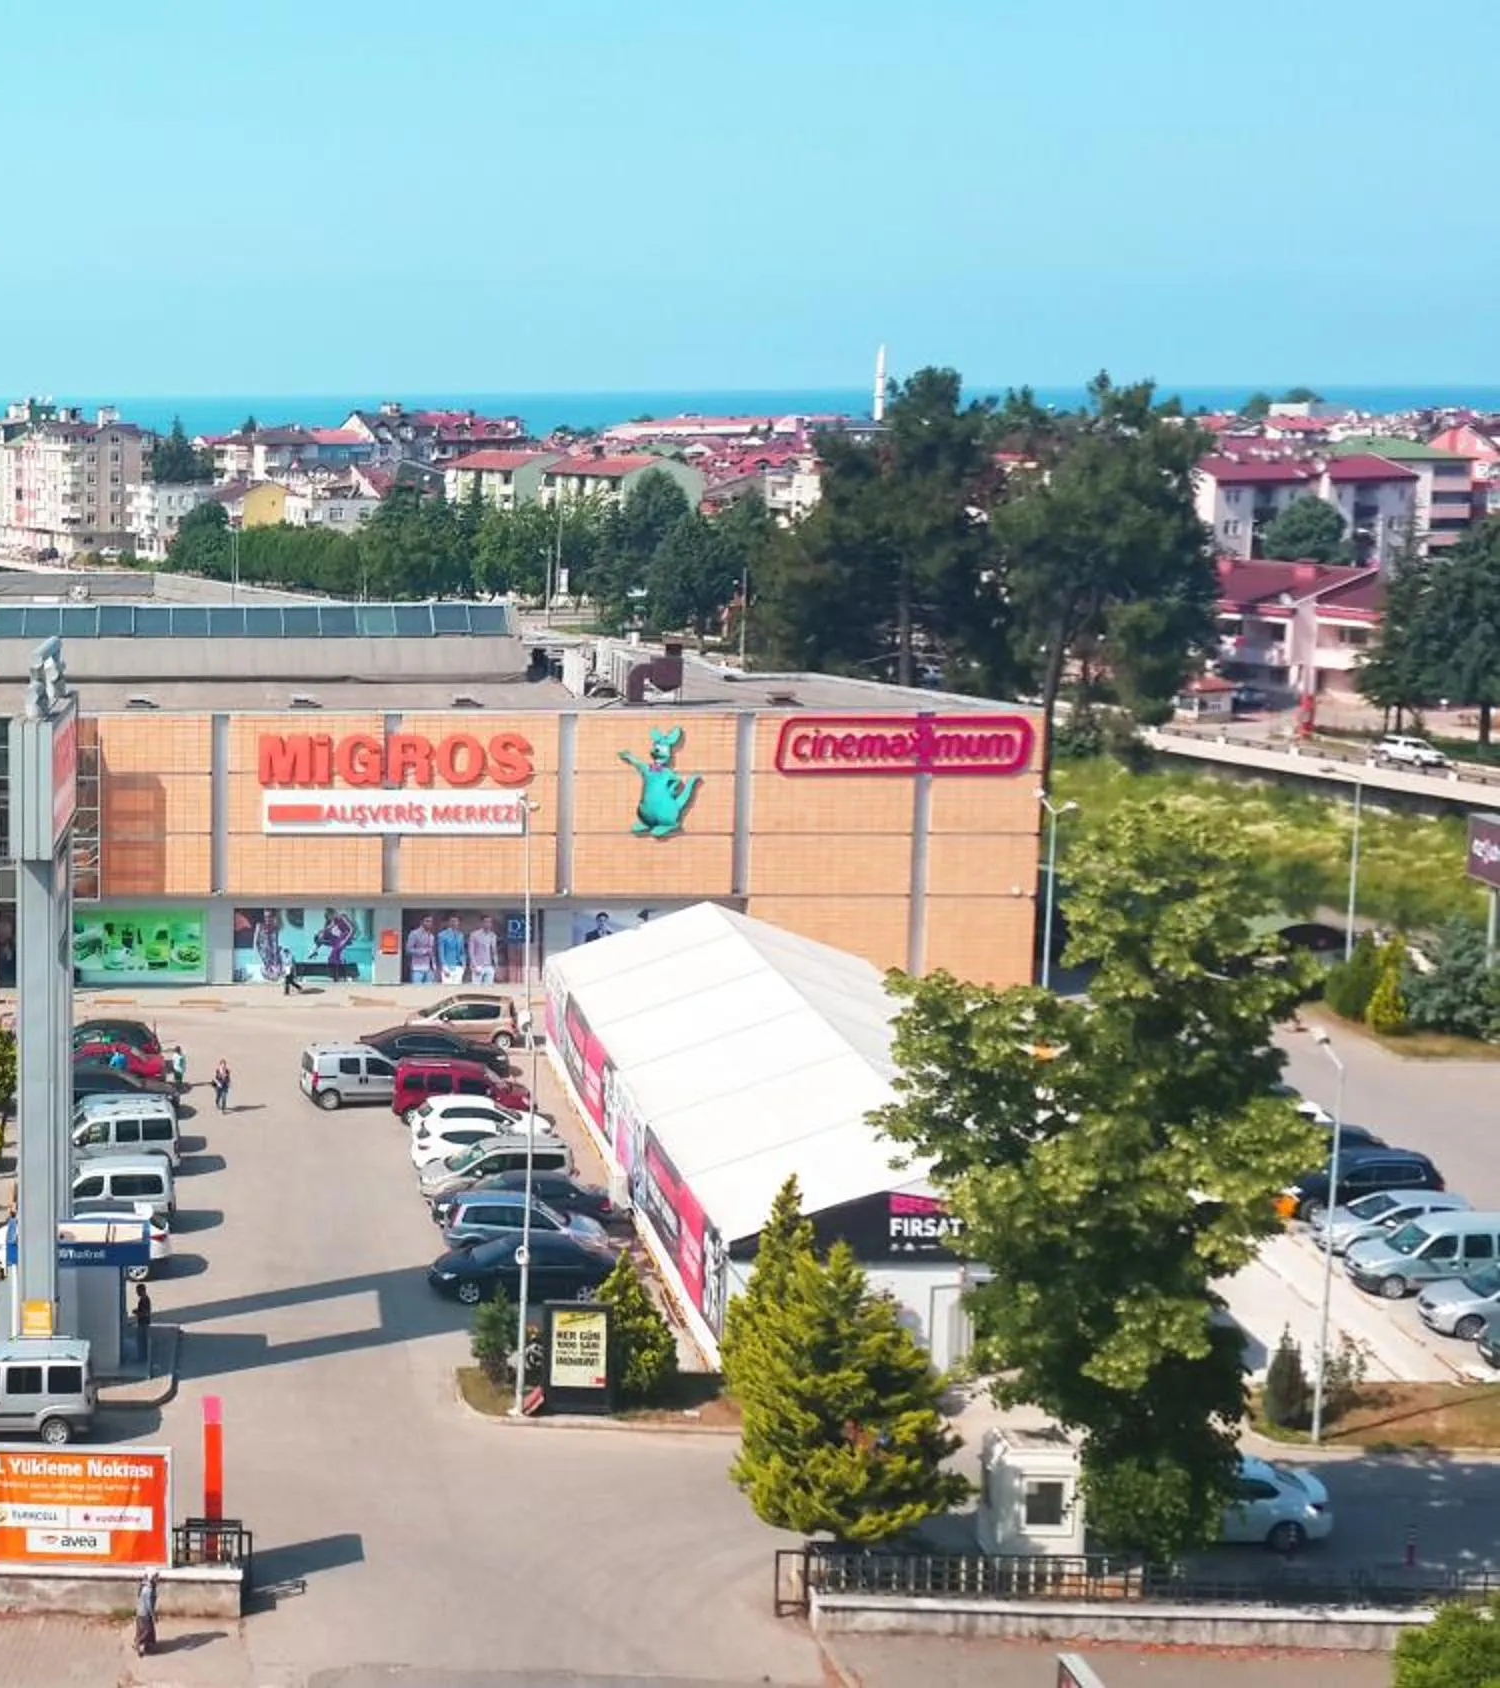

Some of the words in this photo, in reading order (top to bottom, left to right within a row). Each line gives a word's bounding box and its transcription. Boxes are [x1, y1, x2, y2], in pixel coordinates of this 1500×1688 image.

[323, 801, 427, 828] ALIŞVERİŞ
[890, 1217, 964, 1237] FIRSAT
[60, 1535, 98, 1549] avea
